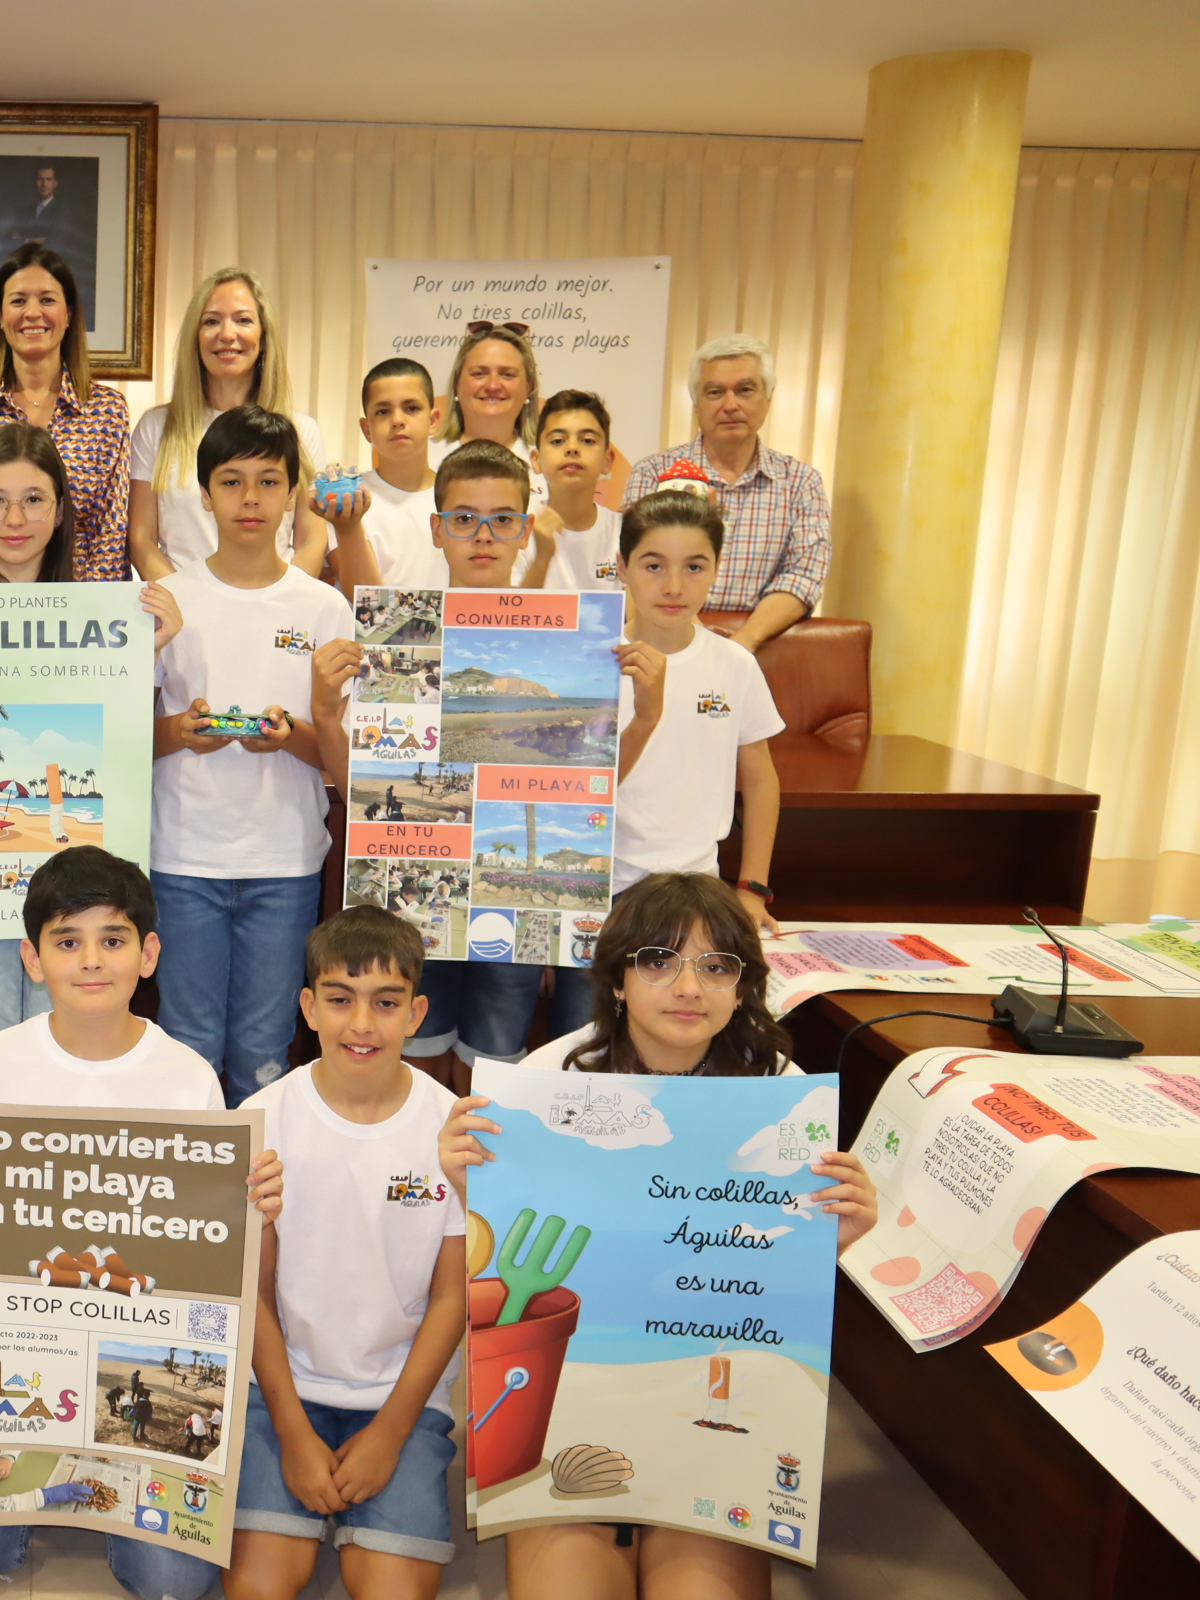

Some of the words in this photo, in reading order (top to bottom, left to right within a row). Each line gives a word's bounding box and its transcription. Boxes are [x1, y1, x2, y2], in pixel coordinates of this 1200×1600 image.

[413, 275, 443, 292] Por
[452, 280, 474, 292] un
[484, 275, 547, 292] mundo
[557, 278, 613, 296] mejor.
[437, 304, 462, 320] No
[473, 304, 511, 320] tires
[521, 304, 587, 324] colillas,
[572, 332, 630, 352] playas
[10, 597, 68, 608] PLANTES
[499, 596, 523, 607] NO
[456, 613, 564, 626] CONVIERTAS
[30, 665, 128, 677] SOMBRILLA
[501, 779, 523, 790] MI
[529, 779, 586, 792] PLAYA
[387, 826, 406, 836] EN
[414, 826, 433, 837] TU
[367, 843, 452, 856] CENICERO
[983, 1097, 1044, 1136] COLILLAS!
[1024, 1099, 1062, 1122] TIRES
[1056, 1121, 1088, 1138] TUS
[779, 1123, 797, 1136] ES
[960, 1114, 986, 1137] CUIDAR
[992, 1138, 1016, 1158] PLAYA
[21, 1128, 236, 1165] conviertas
[778, 1148, 810, 1161] RED
[959, 1128, 980, 1149] TAREA
[988, 1150, 1014, 1174] TODOS
[933, 1138, 950, 1156] TIRES
[957, 1157, 983, 1183] COLILLA
[5, 1161, 54, 1191] mi
[63, 1164, 175, 1206] playa
[925, 1147, 943, 1166] PLAYA
[959, 1175, 993, 1208] PULMONES
[649, 1175, 690, 1200] Sin
[696, 1181, 799, 1210] colillas,
[13, 1202, 53, 1228] tu
[61, 1203, 229, 1243] cenicero
[664, 1216, 774, 1253] Águilas
[676, 1274, 705, 1291] es
[710, 1276, 764, 1297] una
[1147, 1281, 1174, 1305] Tardan
[6, 1295, 63, 1315] STOP
[70, 1301, 171, 1326] COLILLAS
[16, 1331, 58, 1341] 2022-2023
[645, 1317, 783, 1346] maravilla
[12, 1345, 26, 1353] los
[28, 1346, 78, 1357] alumnos/as
[1126, 1346, 1158, 1368] ¿Qué
[1153, 1366, 1182, 1390] daño
[1100, 1386, 1132, 1415] órganos
[1142, 1425, 1172, 1451] cuerpo
[1123, 1380, 1150, 1405] Dañan
[1148, 1403, 1167, 1420] casi
[1164, 1418, 1186, 1437] cada
[172, 1510, 214, 1528] Ayuntamiento
[767, 1501, 806, 1520] Águilas
[172, 1525, 212, 1546] Águilas
